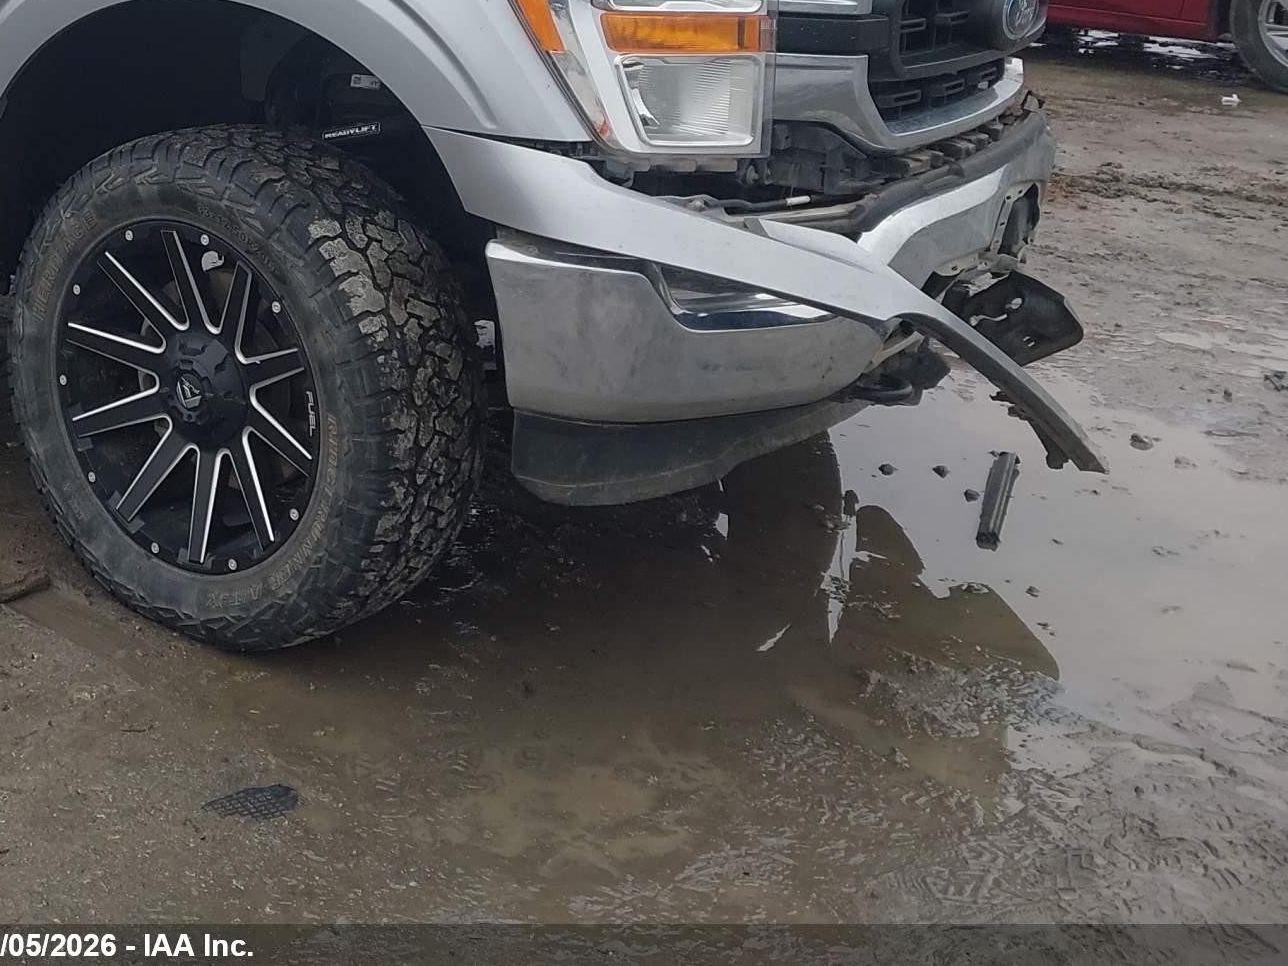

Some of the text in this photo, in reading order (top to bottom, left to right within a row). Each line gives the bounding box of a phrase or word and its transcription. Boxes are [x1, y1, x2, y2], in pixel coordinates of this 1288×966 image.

[324, 124, 376, 139] READYLIFT
[31, 209, 98, 322] HERITAGE
[305, 390, 316, 437] FUEL
